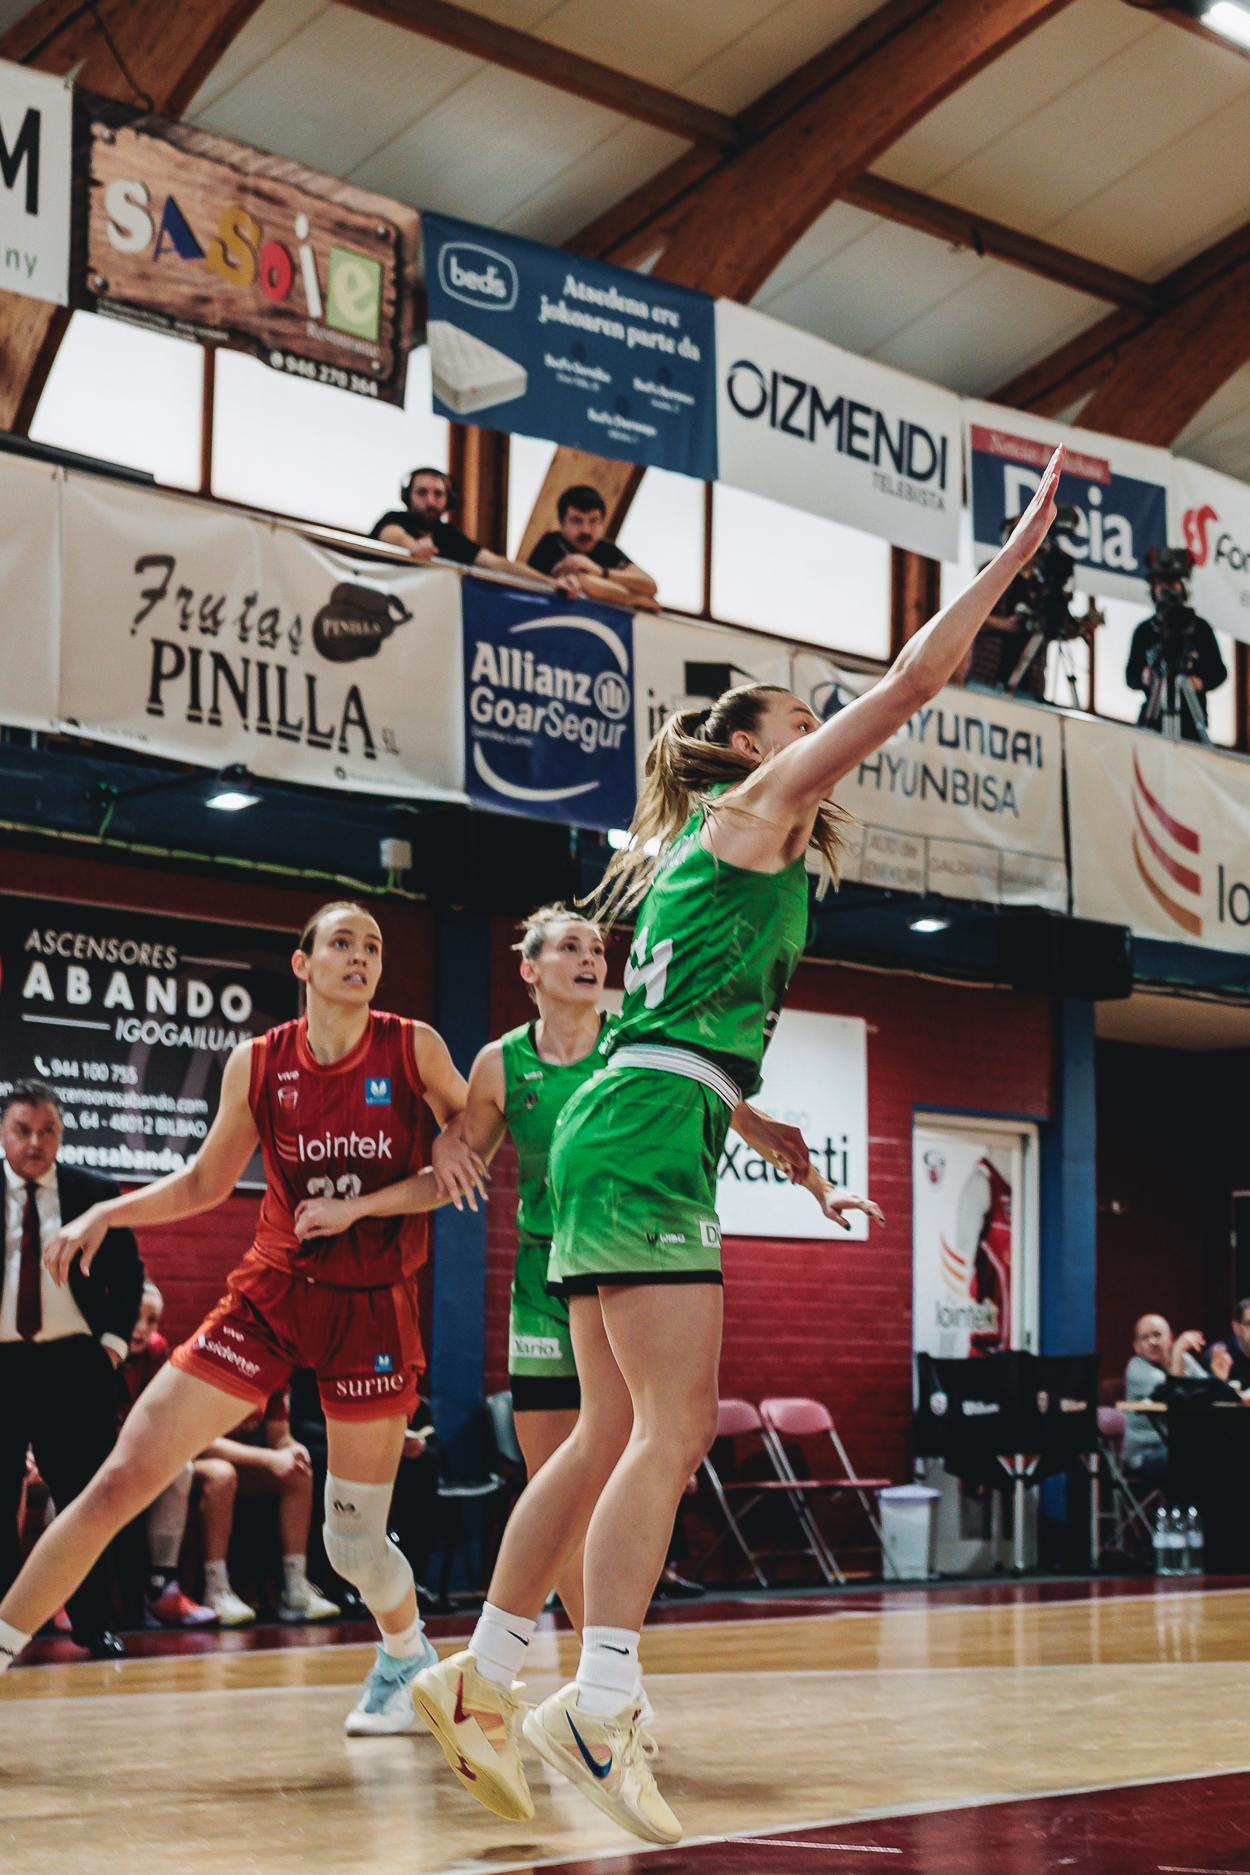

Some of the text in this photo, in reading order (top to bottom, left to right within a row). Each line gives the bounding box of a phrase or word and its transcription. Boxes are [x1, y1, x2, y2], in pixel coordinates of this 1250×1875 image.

[726, 360, 948, 491] OIZMENDI
[130, 553, 303, 656] Frutas
[146, 637, 378, 760] PINILLA
[471, 641, 592, 707] Allianz
[857, 751, 1020, 818] HYUNBISA
[24, 928, 178, 970] ASCENSORES
[22, 960, 252, 1024] ABANDO
[83, 1061, 110, 1082] 100
[298, 1130, 392, 1162] lointek
[336, 1372, 404, 1398] surne
